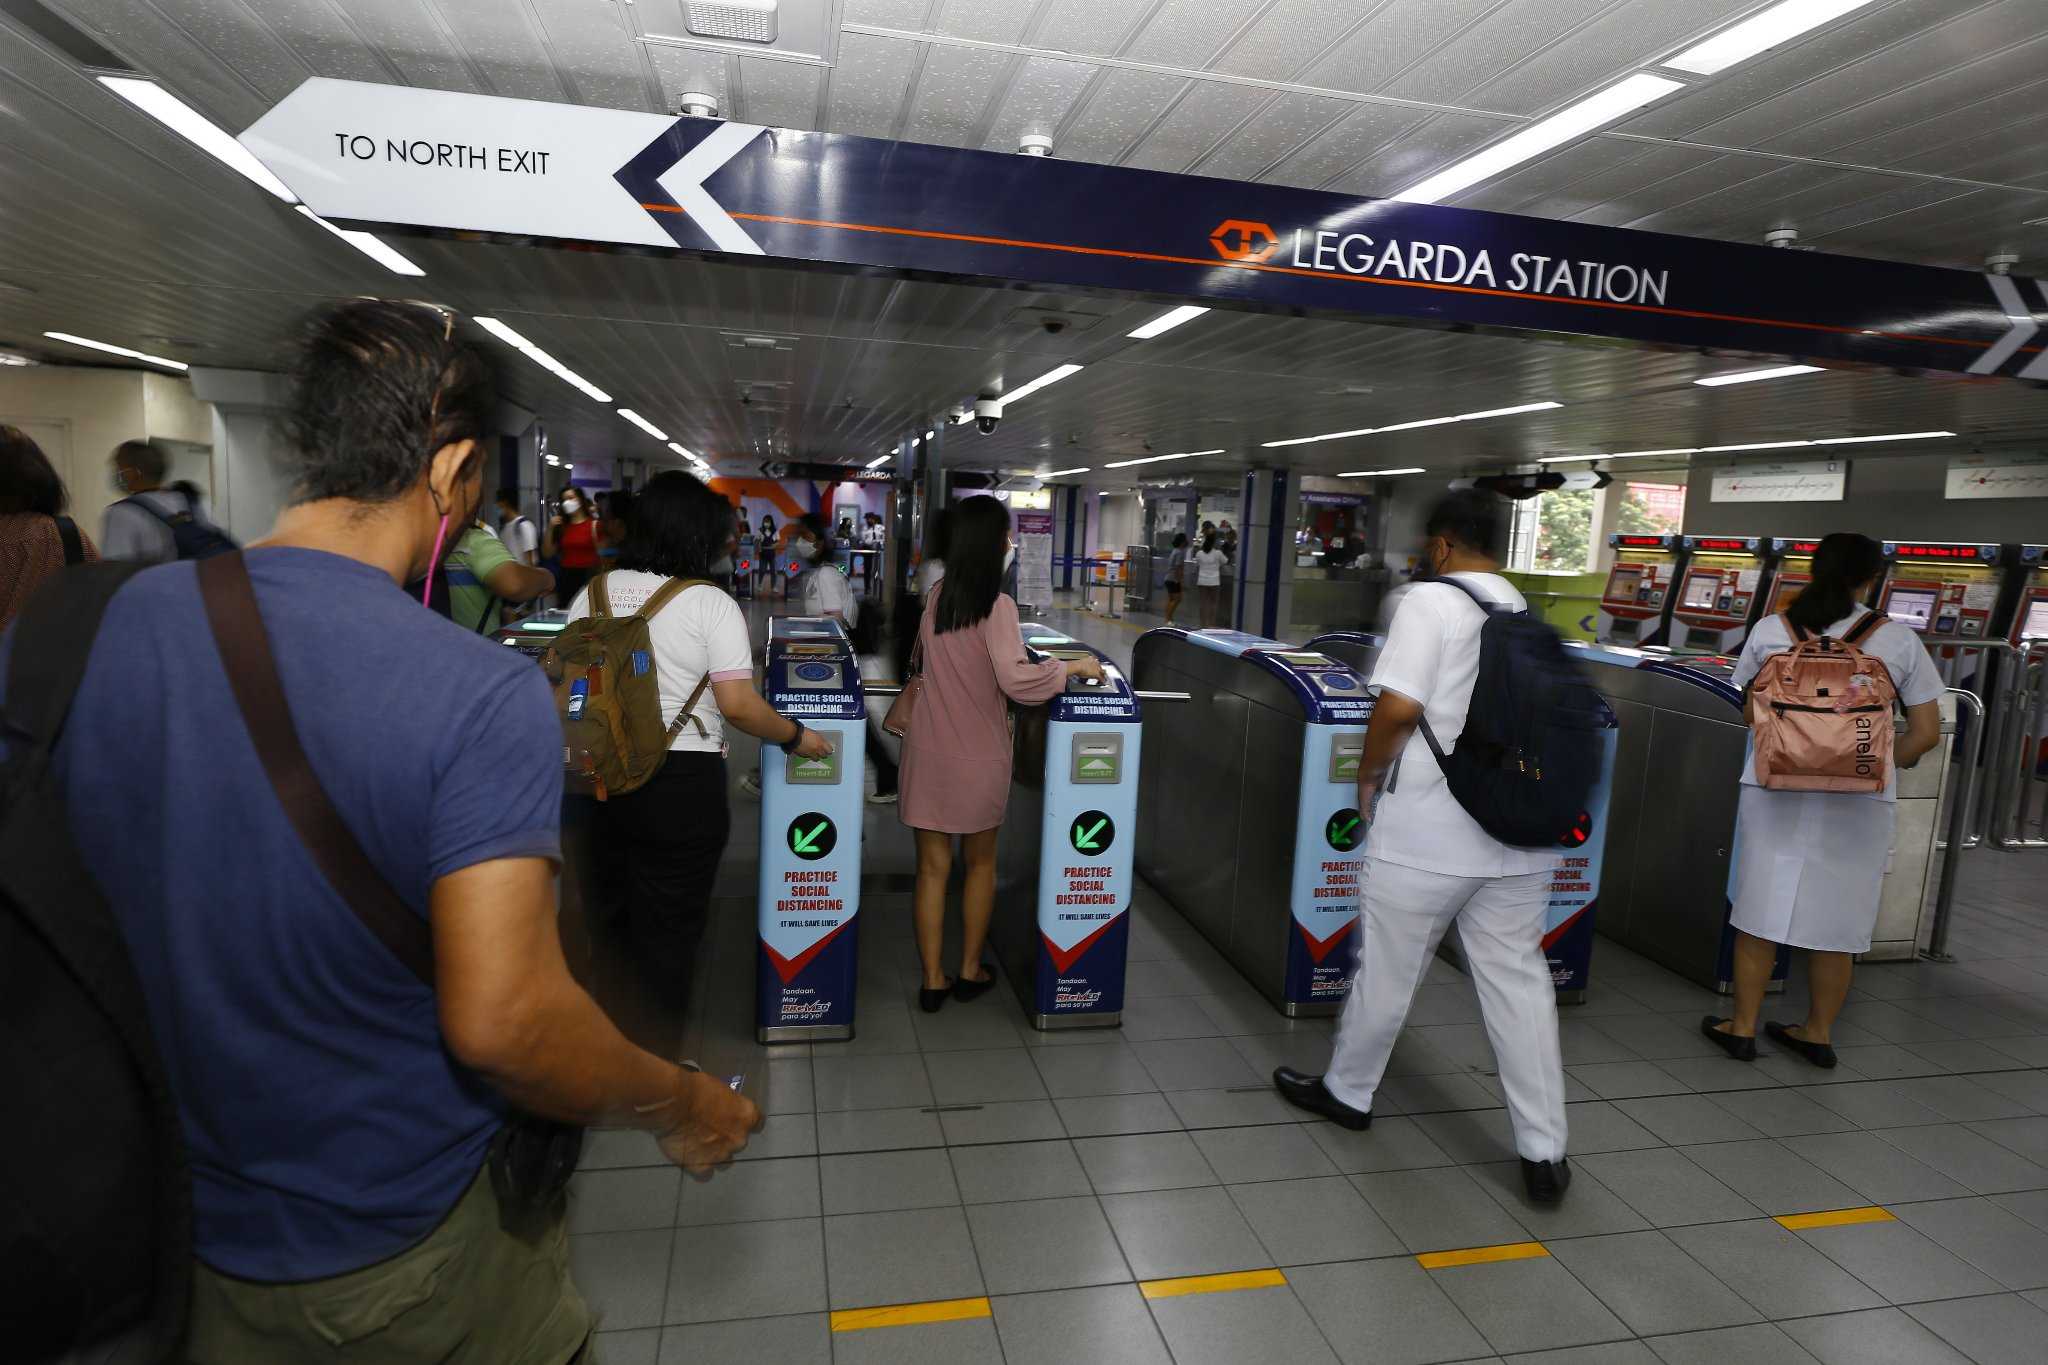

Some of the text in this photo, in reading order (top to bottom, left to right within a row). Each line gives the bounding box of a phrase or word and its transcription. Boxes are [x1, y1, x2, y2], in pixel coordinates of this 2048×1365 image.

[335, 133, 550, 175] TO NORTH EXIT
[1290, 228, 1669, 306] LEGARDA STATION
[856, 471, 891, 480] LEGARDA
[613, 588, 653, 597] CENTR
[610, 594, 643, 603] ESCOL
[776, 693, 855, 703] PRACTICE SOCIAL
[1062, 696, 1134, 706] PRACTICE SOCIAL
[787, 704, 843, 714] DISTANCING
[1073, 705, 1125, 715] DISTANCING
[1333, 710, 1372, 719] DISTANC
[1855, 718, 1877, 776] anello
[784, 871, 839, 882] PRACTICE
[1064, 866, 1113, 878] PRACTICE
[1552, 870, 1584, 880] SOCIAL
[1326, 874, 1358, 885] SOCIAL
[791, 885, 831, 897] SOCIAL
[1069, 880, 1105, 892] SOCIAL
[1547, 882, 1592, 892] STANCING
[1313, 887, 1361, 898] DISTANCI
[1056, 893, 1117, 905] DISTANCING
[777, 899, 844, 911] DISTANCING
[780, 920, 787, 928] IT
[788, 920, 804, 928] WILL
[821, 919, 839, 927] LIVES
[782, 996, 799, 1004] May
